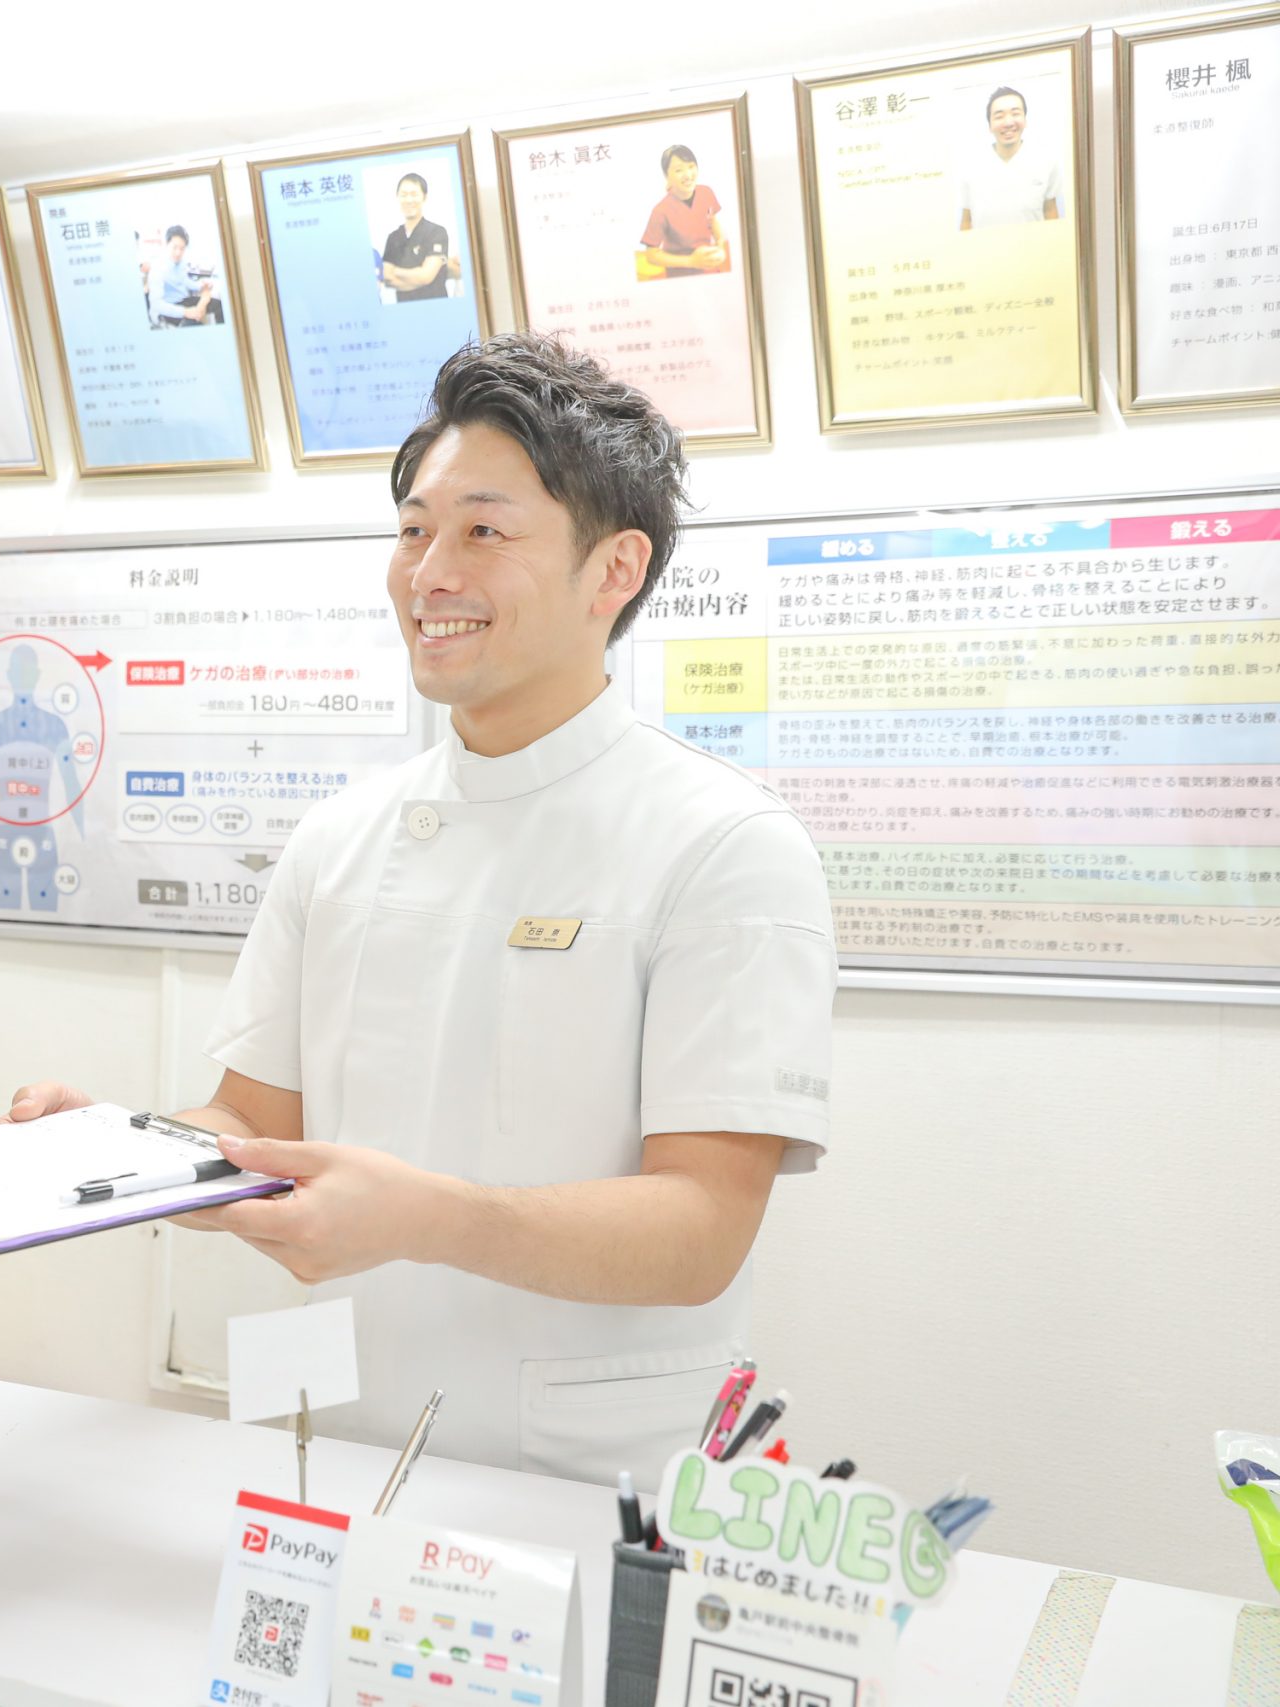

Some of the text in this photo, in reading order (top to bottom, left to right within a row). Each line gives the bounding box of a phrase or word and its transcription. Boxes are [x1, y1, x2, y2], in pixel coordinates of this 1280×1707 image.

[1165, 58, 1252, 91] 櫻井 楓
[529, 150, 566, 171] 鈴木
[280, 173, 355, 200] 橋本 英俊
[60, 221, 91, 241] 石田
[129, 567, 199, 588] 料金説明
[647, 592, 748, 618] 治療内容
[684, 662, 743, 678] 保険治療
[685, 725, 743, 740] 基本治療
[148, 886, 177, 902] 合計
[270, 1533, 338, 1569] PayPay
[446, 1546, 493, 1580] Pay
